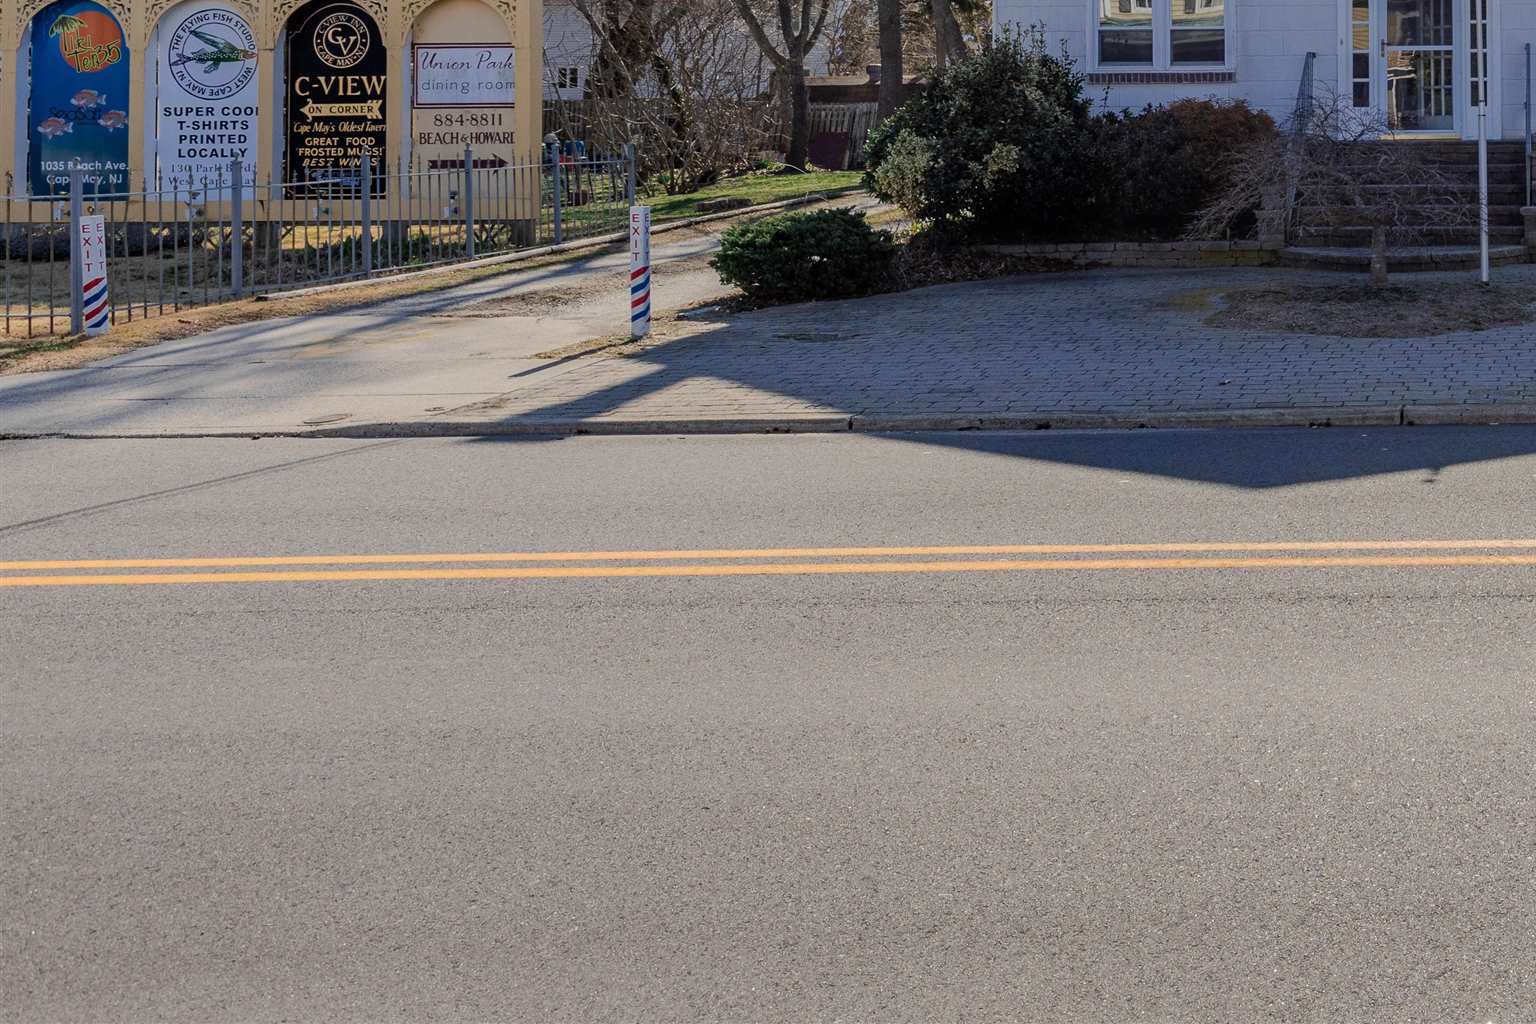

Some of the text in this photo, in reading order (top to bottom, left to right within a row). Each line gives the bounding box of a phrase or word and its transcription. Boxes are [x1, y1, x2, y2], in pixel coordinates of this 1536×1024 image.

[171, 13, 256, 52] THE FLYING FISH STUDIO
[350, 18, 366, 34] INN
[317, 44, 336, 64] CAPE
[421, 50, 514, 71] Union Park
[175, 70, 187, 82] NJ
[235, 66, 253, 89] WEST
[208, 85, 232, 97] CAPE
[294, 75, 387, 96] C-VIEW
[421, 80, 470, 95] dining
[163, 106, 215, 117] SUPER
[308, 105, 375, 114] ON CORNER
[177, 120, 249, 131] T-SHIRTS
[433, 113, 503, 127] 884-8811
[311, 121, 337, 135] May's
[338, 121, 365, 133] Oldest
[179, 134, 247, 145] PRINTED
[305, 137, 376, 146] GREAT FOOD
[419, 132, 459, 145] BEACH
[178, 148, 248, 159] LOCALLY
[40, 161, 129, 171] 1035 Bach Ave.
[225, 163, 251, 173] Bd
[302, 157, 378, 167] BEST WINS
[46, 174, 72, 185] Cap
[109, 174, 123, 184] NJ
[632, 214, 640, 262] EXIT
[82, 224, 93, 272] EXIT
[96, 223, 104, 271] EXIT
